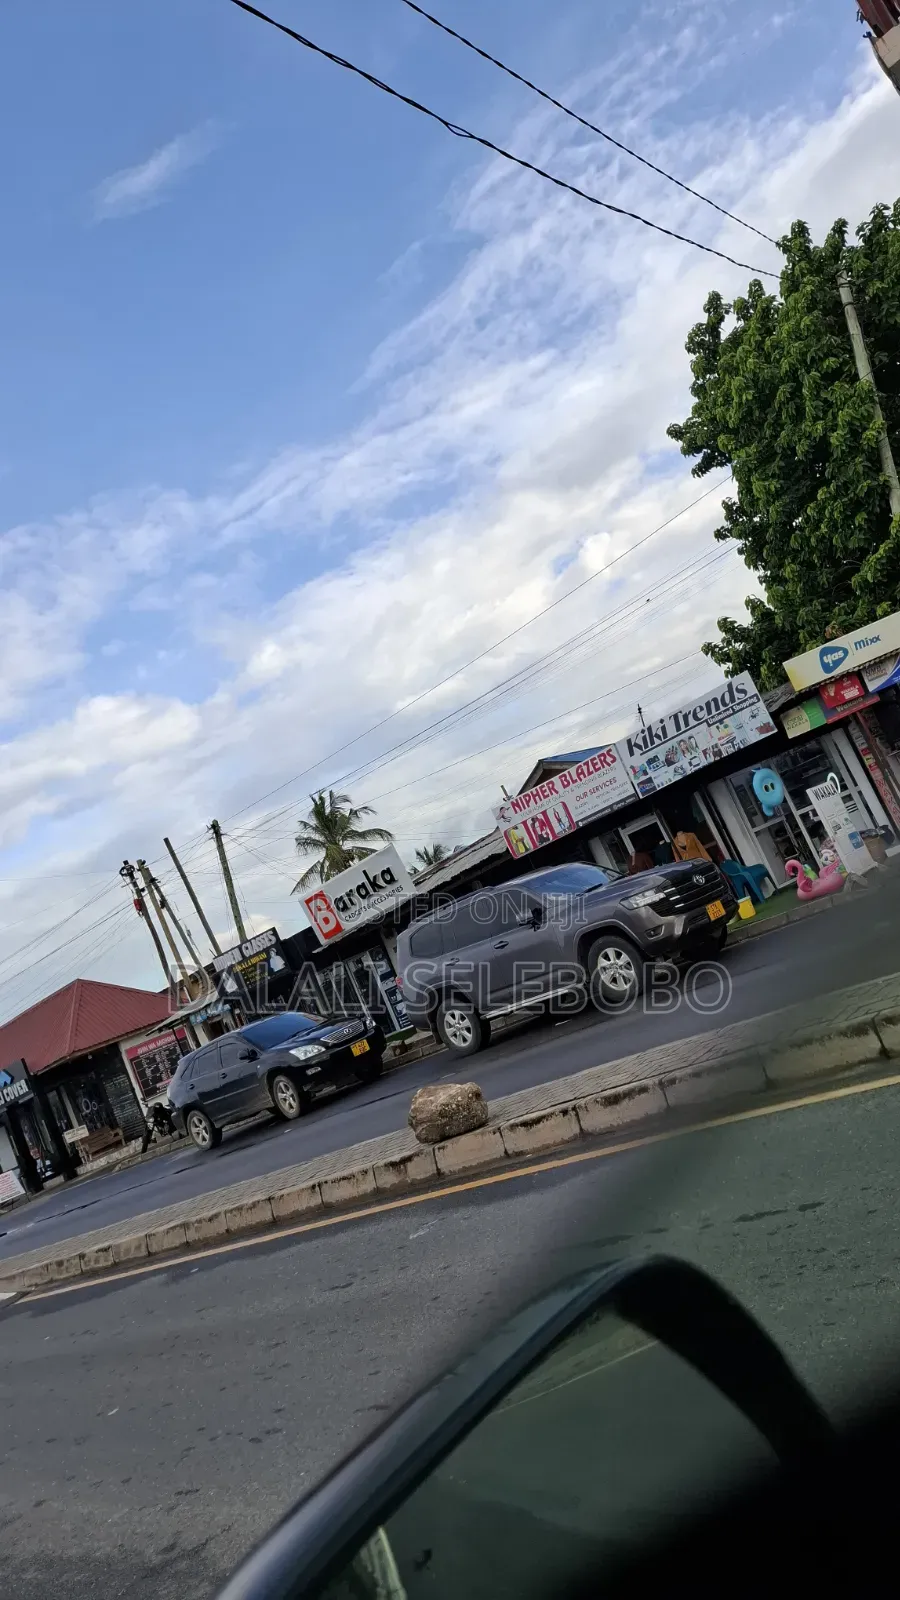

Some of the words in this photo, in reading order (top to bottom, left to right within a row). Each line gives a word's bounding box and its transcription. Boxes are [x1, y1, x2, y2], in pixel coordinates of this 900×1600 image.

[822, 649, 845, 667] yas
[733, 694, 758, 712] Shopping
[626, 718, 668, 757] Kiki
[669, 681, 748, 733] Trends
[510, 780, 559, 814] NIPHER
[558, 748, 617, 789] BLAZERS
[575, 790, 588, 802] OUR
[588, 776, 617, 796] SERVICES
[812, 784, 838, 801] WAKALA
[308, 867, 398, 934] Baraka
[241, 930, 276, 957] GLASSES
[3, 1079, 29, 1102] COVER
